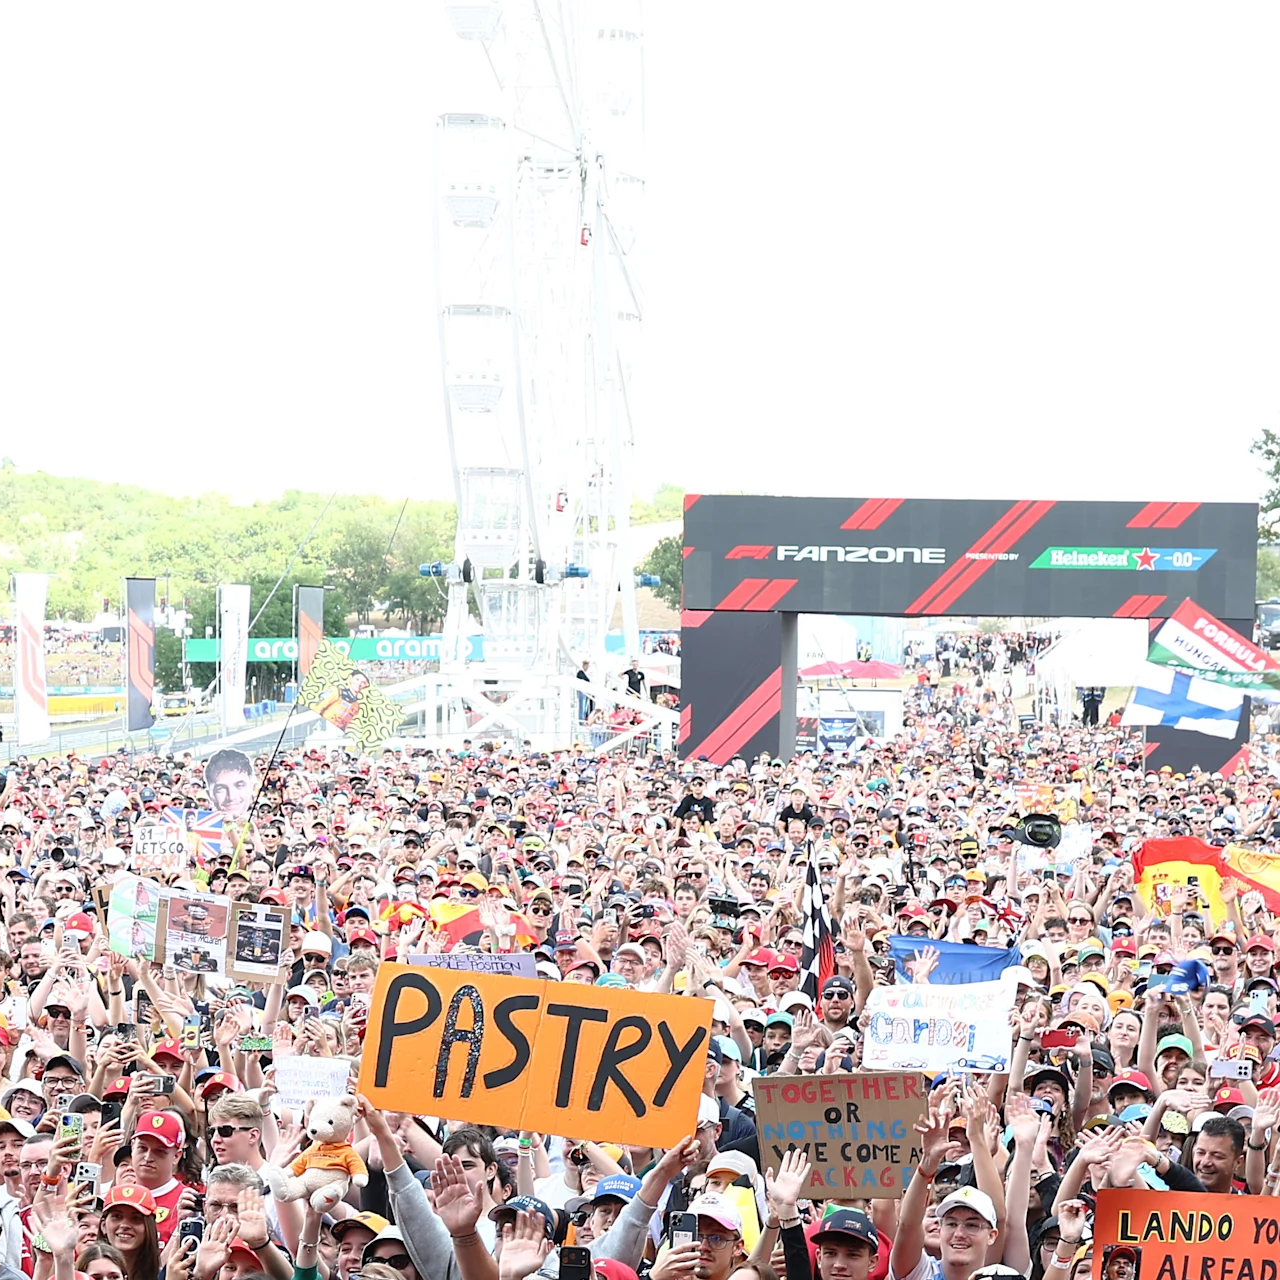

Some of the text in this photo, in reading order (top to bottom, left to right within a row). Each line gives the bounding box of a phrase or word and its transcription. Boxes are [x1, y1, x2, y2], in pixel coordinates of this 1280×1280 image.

[777, 546, 946, 564] FANZONE
[1051, 550, 1128, 566] Heineken
[1193, 617, 1266, 671] FORMULA
[140, 827, 180, 840] 81 P1
[135, 841, 164, 854] LET'S
[135, 855, 180, 868] OSCAR!
[471, 962, 521, 971] POSITION
[374, 972, 707, 1118] PASTRY
[759, 1075, 921, 1104] TOGETHER
[824, 1102, 861, 1123] OR
[763, 1120, 907, 1140] NOTHING
[841, 1143, 901, 1164] COME
[603, 1180, 634, 1189] WILLIAMS
[1118, 1210, 1234, 1244] LANDO
